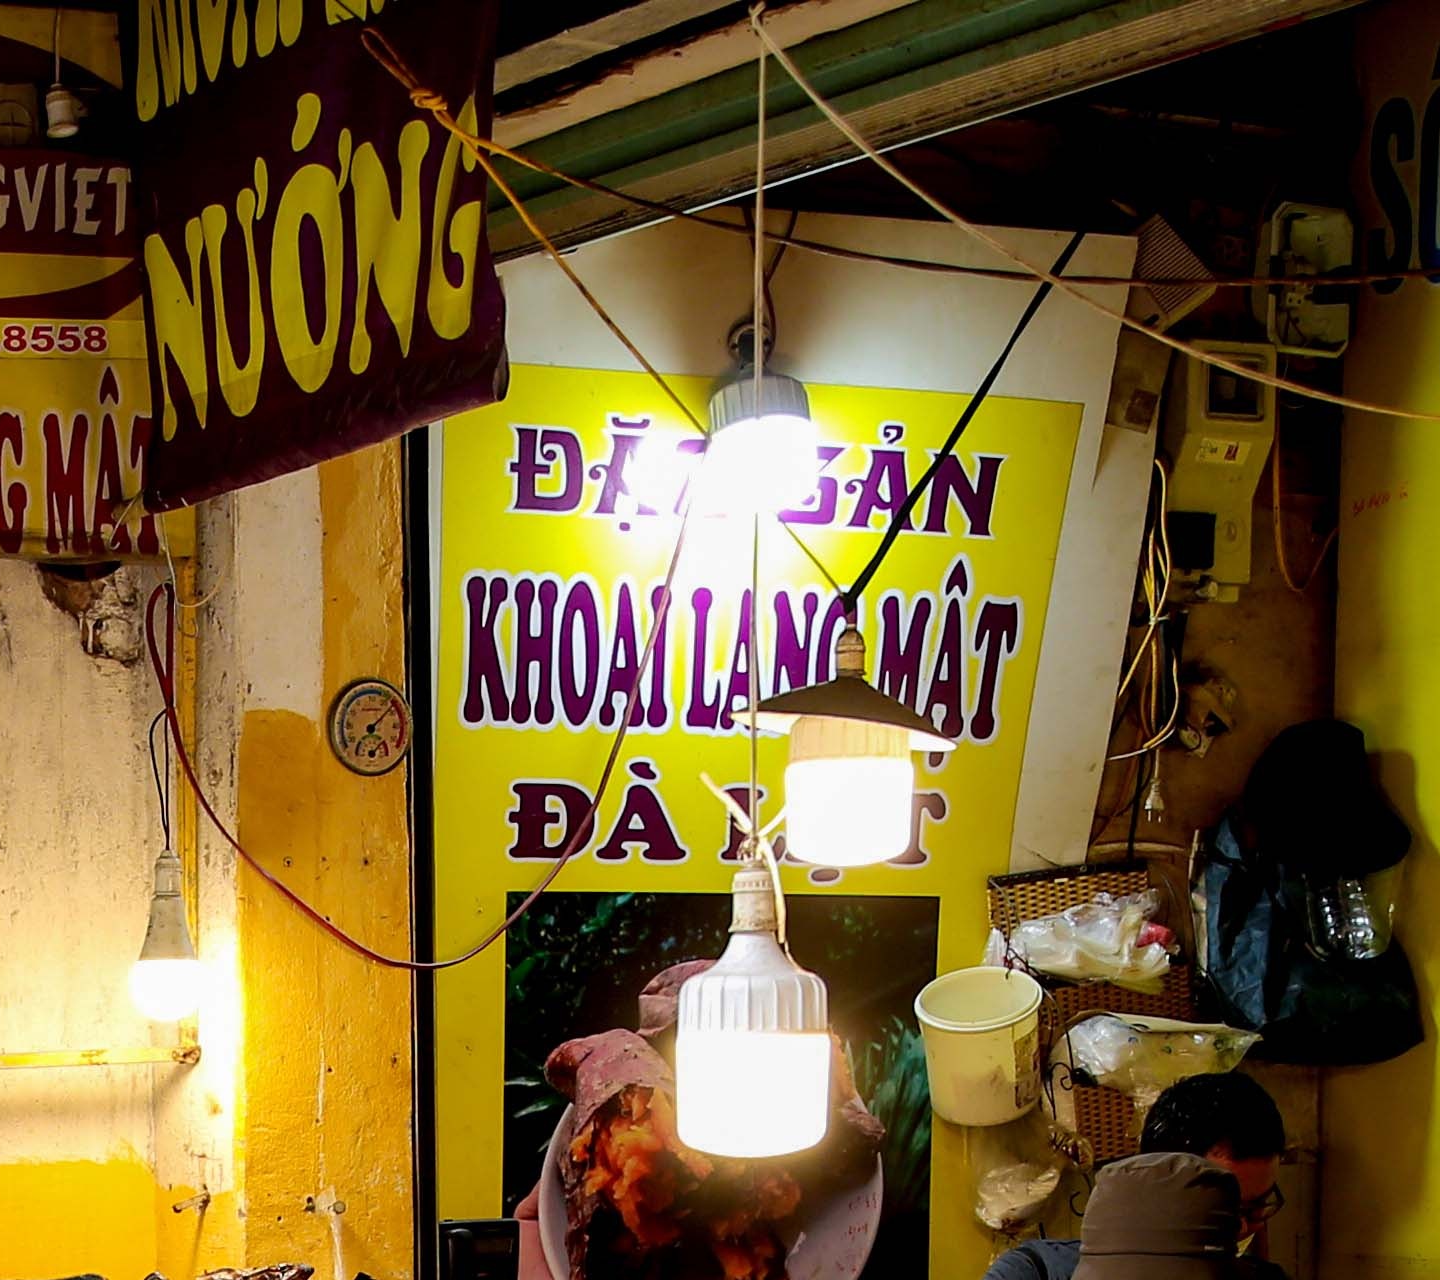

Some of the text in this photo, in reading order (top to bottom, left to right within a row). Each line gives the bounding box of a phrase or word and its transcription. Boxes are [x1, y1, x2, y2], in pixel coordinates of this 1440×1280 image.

[144, 92, 481, 441] NƯỚNG
[463, 576, 673, 725] KHOAI
[508, 761, 689, 862] ĐÀ
